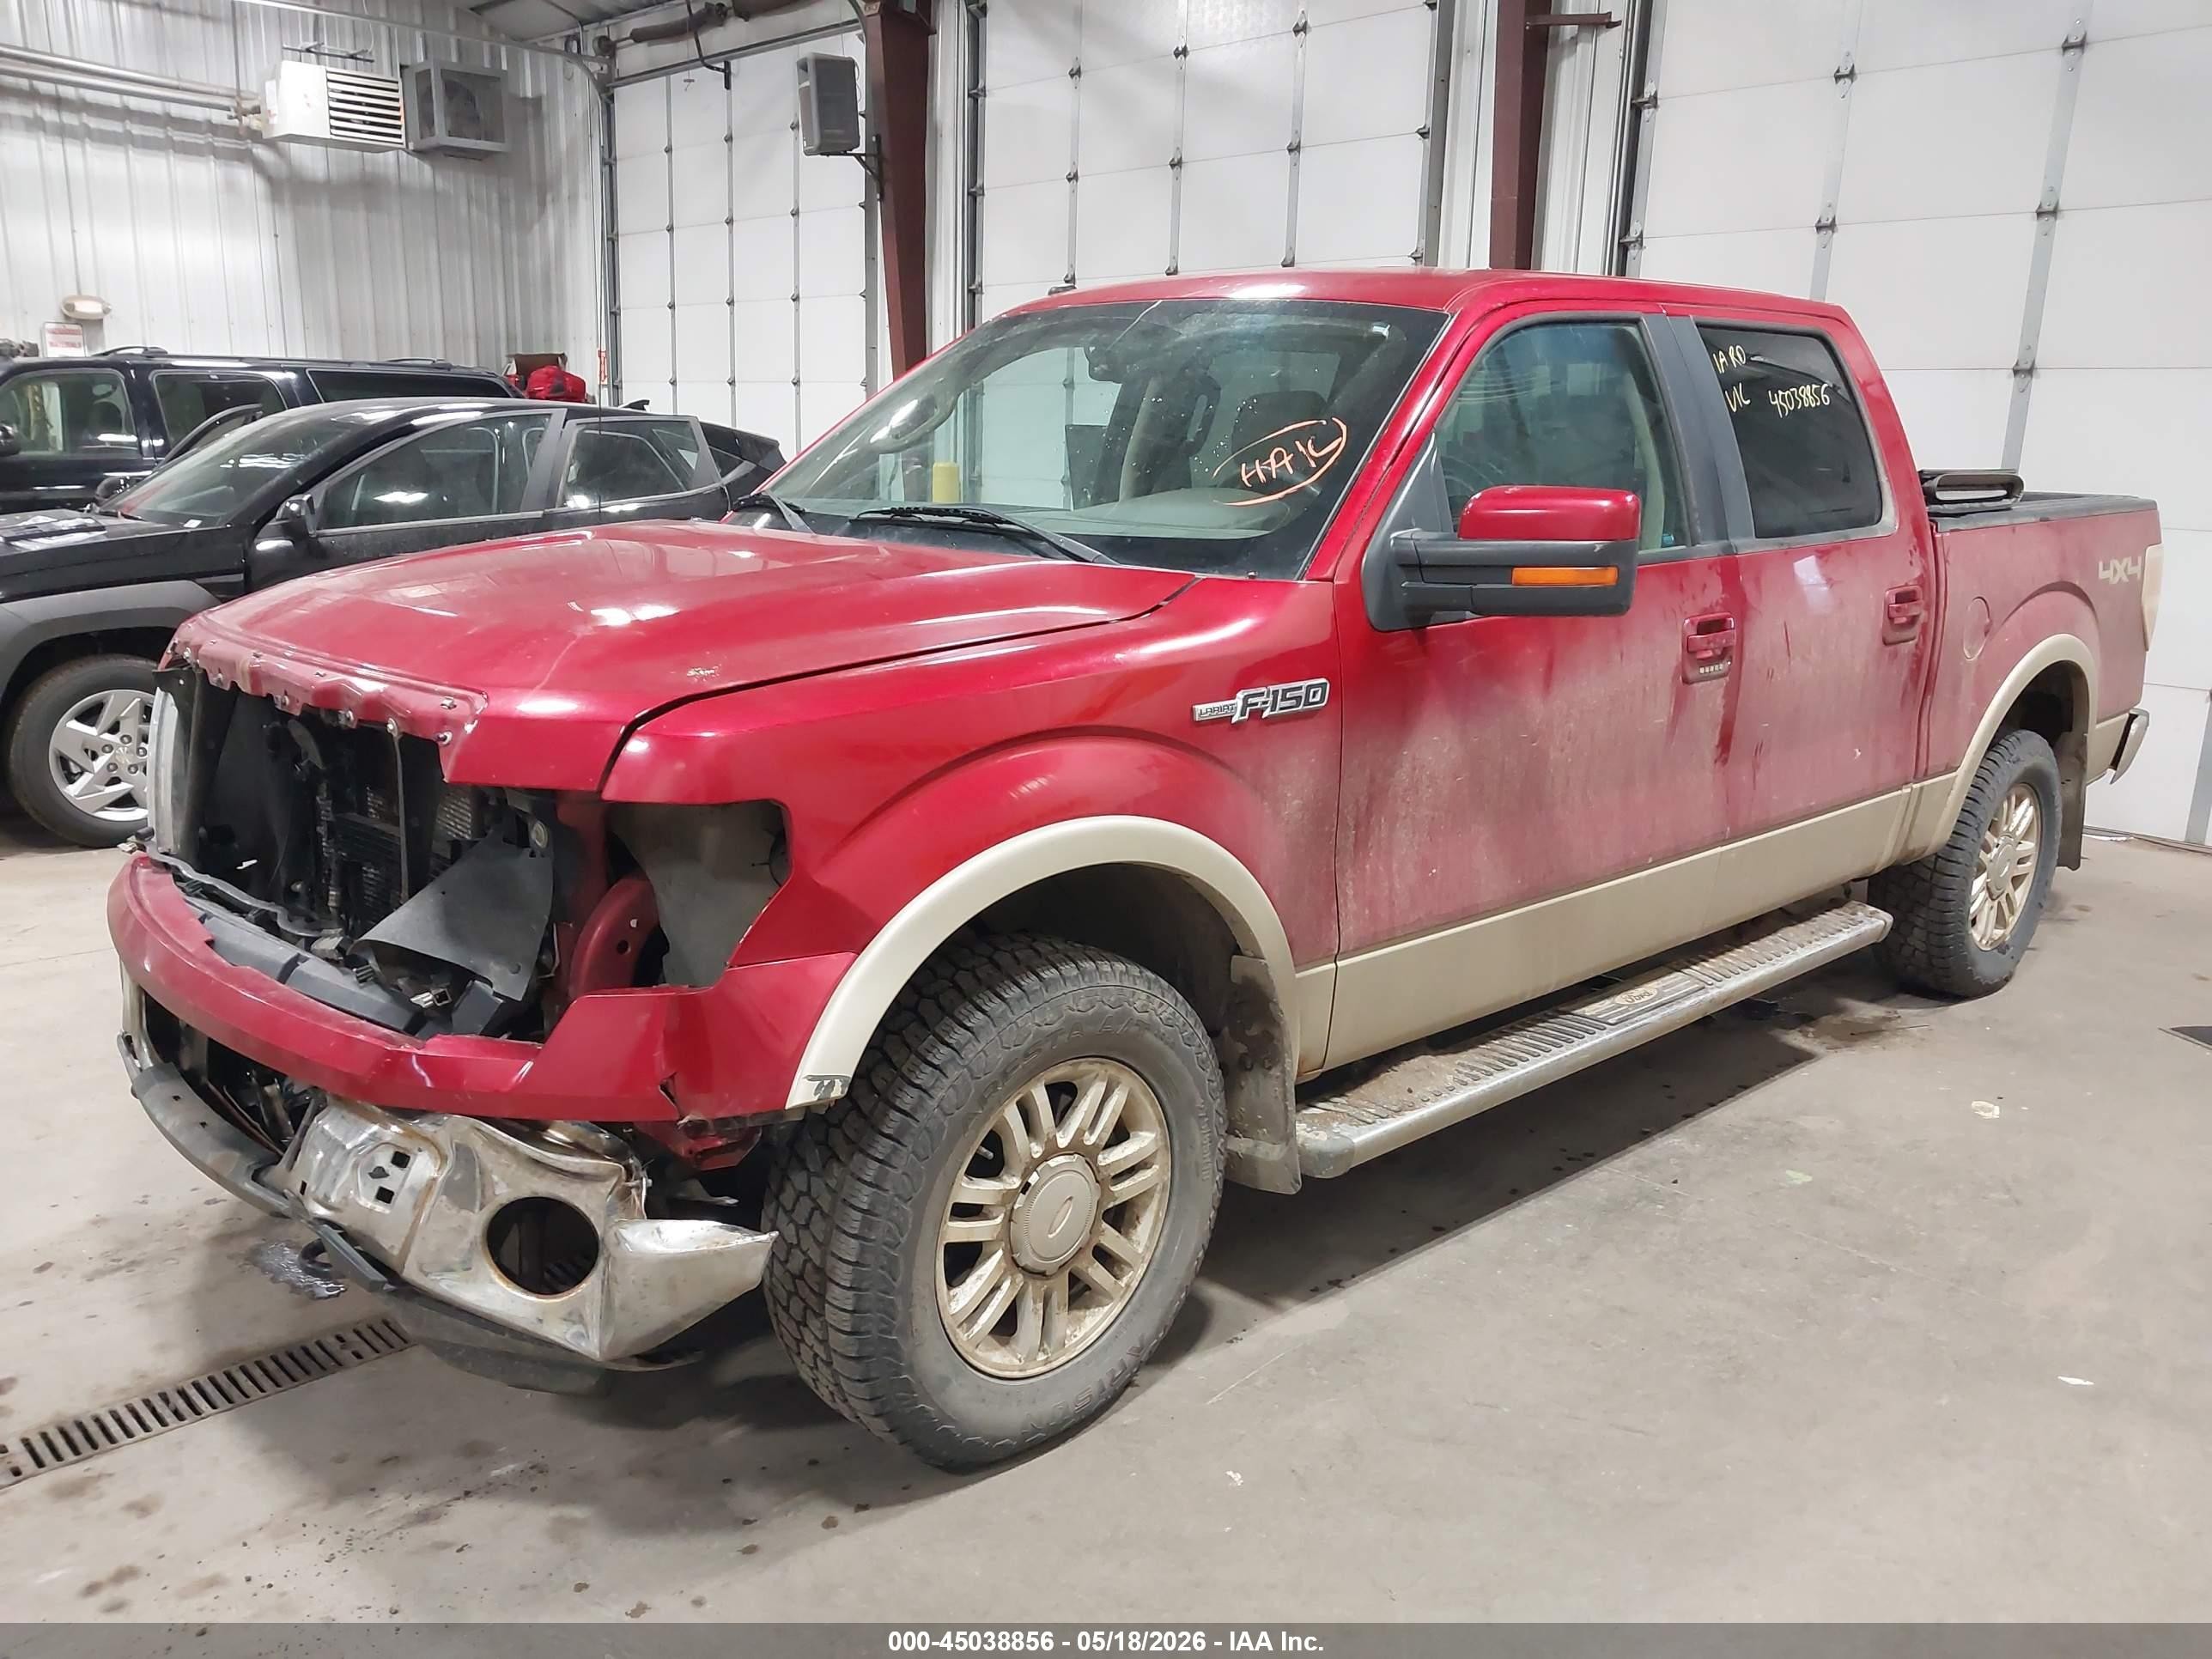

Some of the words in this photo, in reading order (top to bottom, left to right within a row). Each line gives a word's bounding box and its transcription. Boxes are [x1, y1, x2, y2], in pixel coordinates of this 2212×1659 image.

[1768, 383, 1830, 418] 45038856
[1199, 703, 1237, 716] LARIAT
[1234, 678, 1330, 721] F-150
